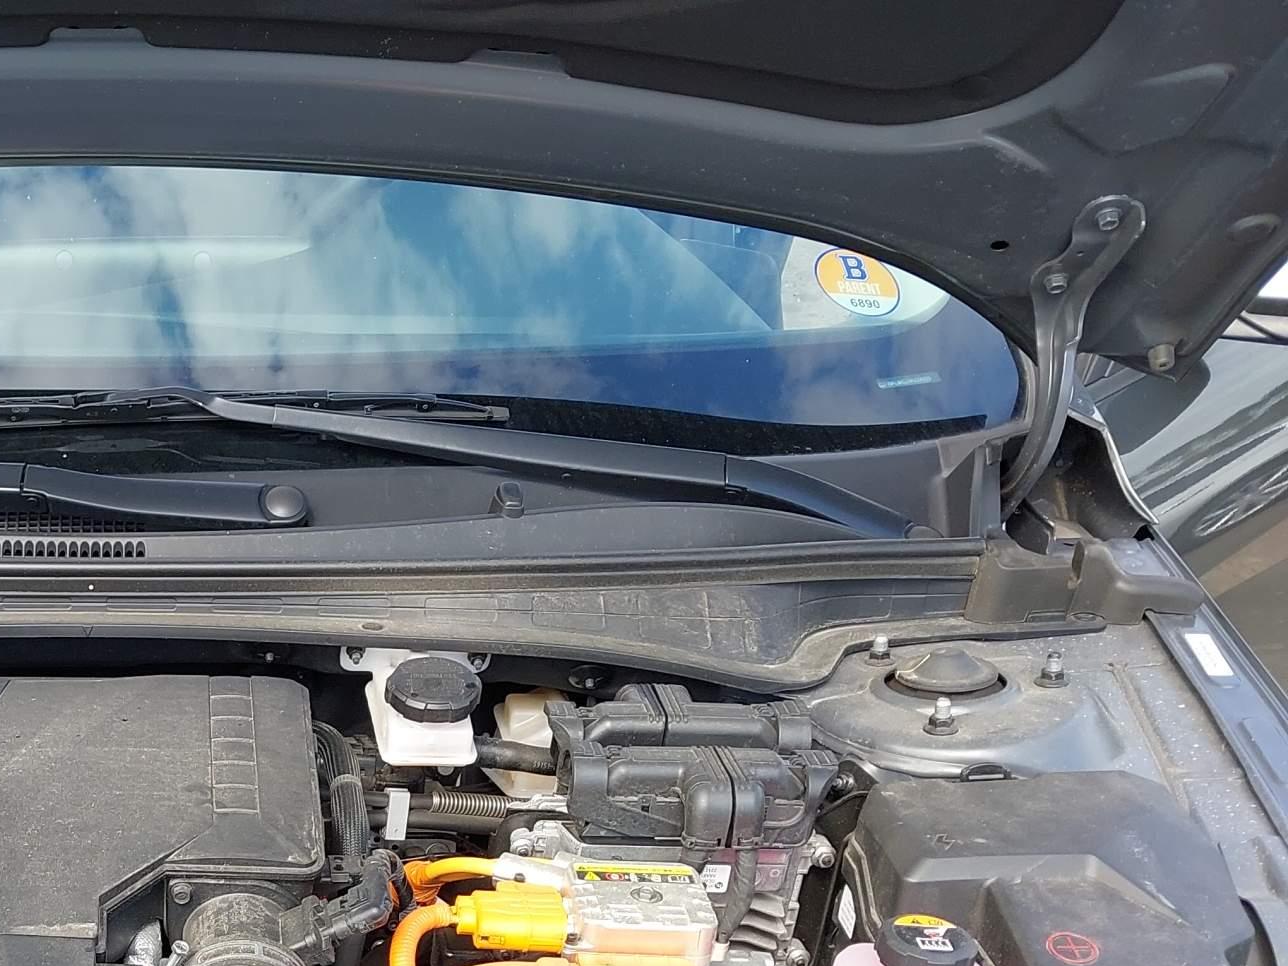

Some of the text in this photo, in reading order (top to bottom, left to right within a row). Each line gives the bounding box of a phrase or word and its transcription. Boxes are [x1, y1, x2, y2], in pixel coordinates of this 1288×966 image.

[838, 255, 867, 280] B
[837, 281, 880, 295] PARENT
[850, 298, 880, 309] 6890
